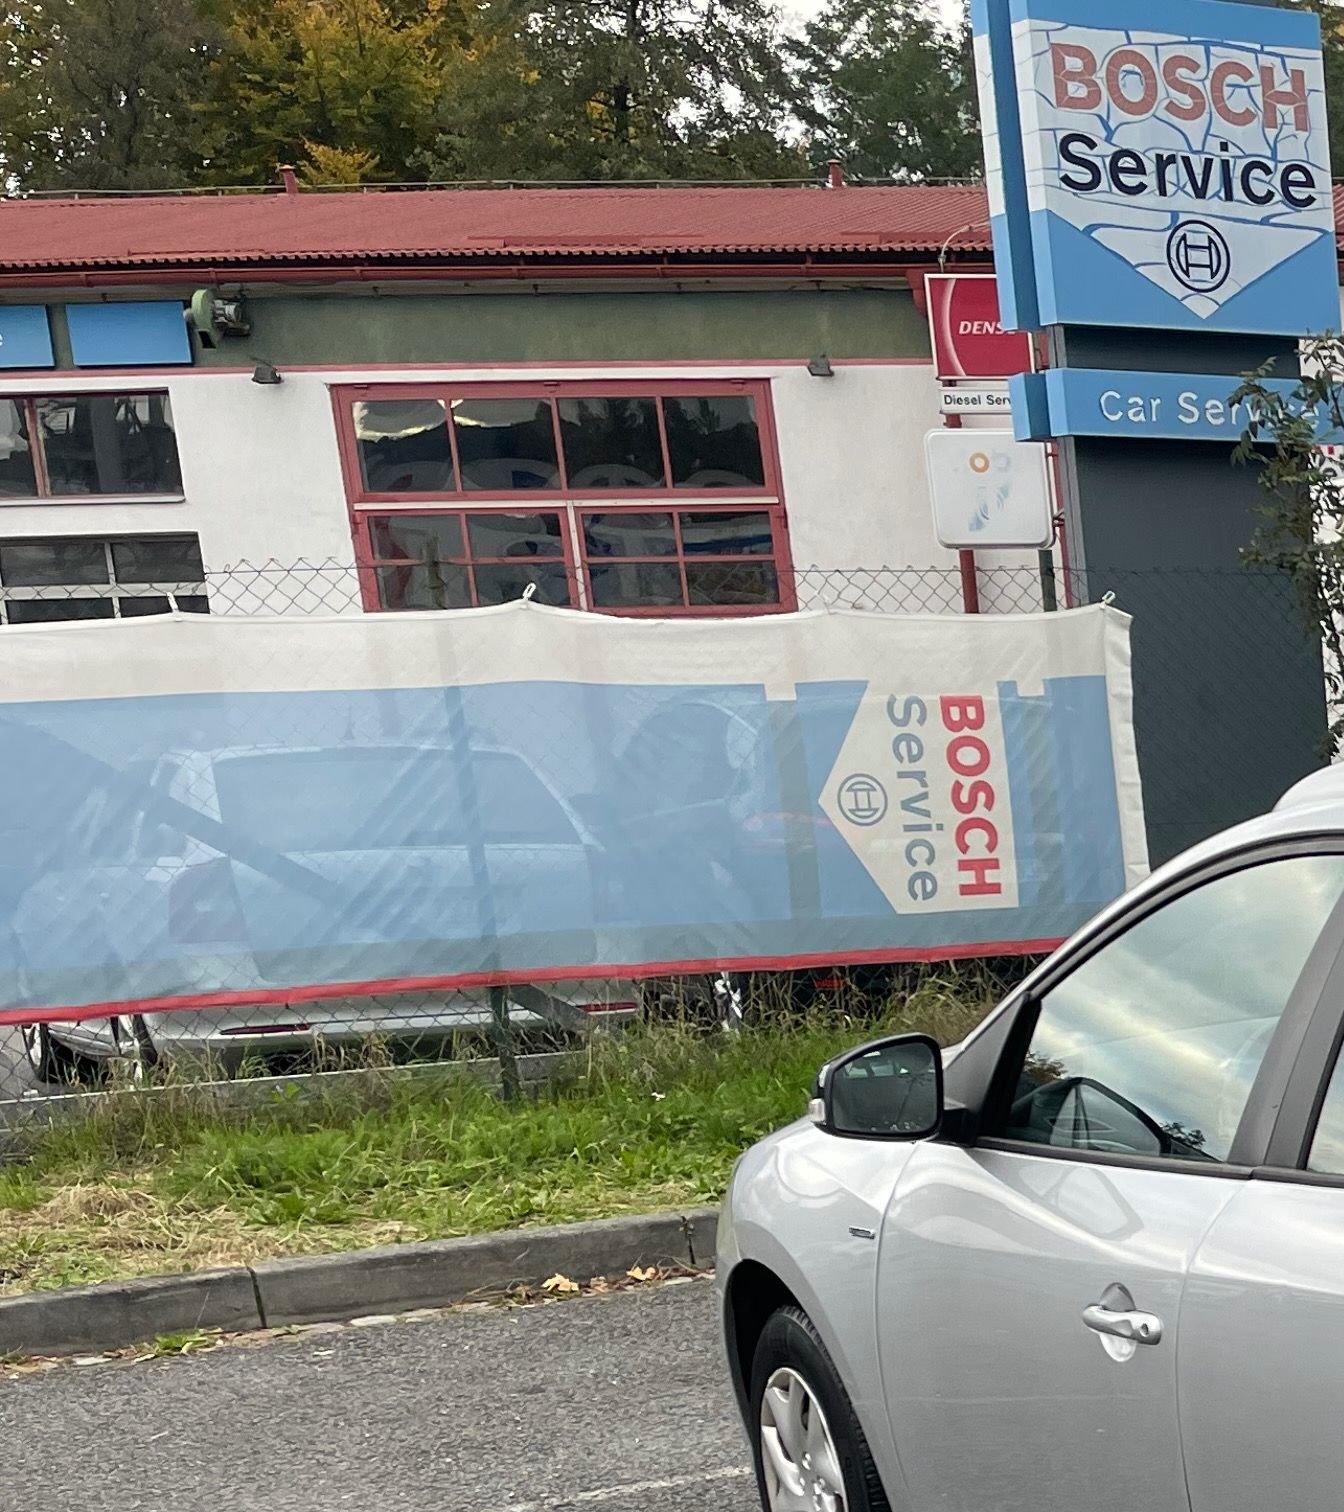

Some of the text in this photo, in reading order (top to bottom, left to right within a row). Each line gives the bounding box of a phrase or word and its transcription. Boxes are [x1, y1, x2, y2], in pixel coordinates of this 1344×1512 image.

[1051, 43, 1308, 132] BOSCH
[1059, 133, 1317, 207] Service
[959, 320, 1015, 334] DENS
[943, 394, 981, 405] Diesel
[1100, 390, 1161, 422] Car
[886, 694, 944, 901] Service
[939, 695, 1002, 896] BOSCH
